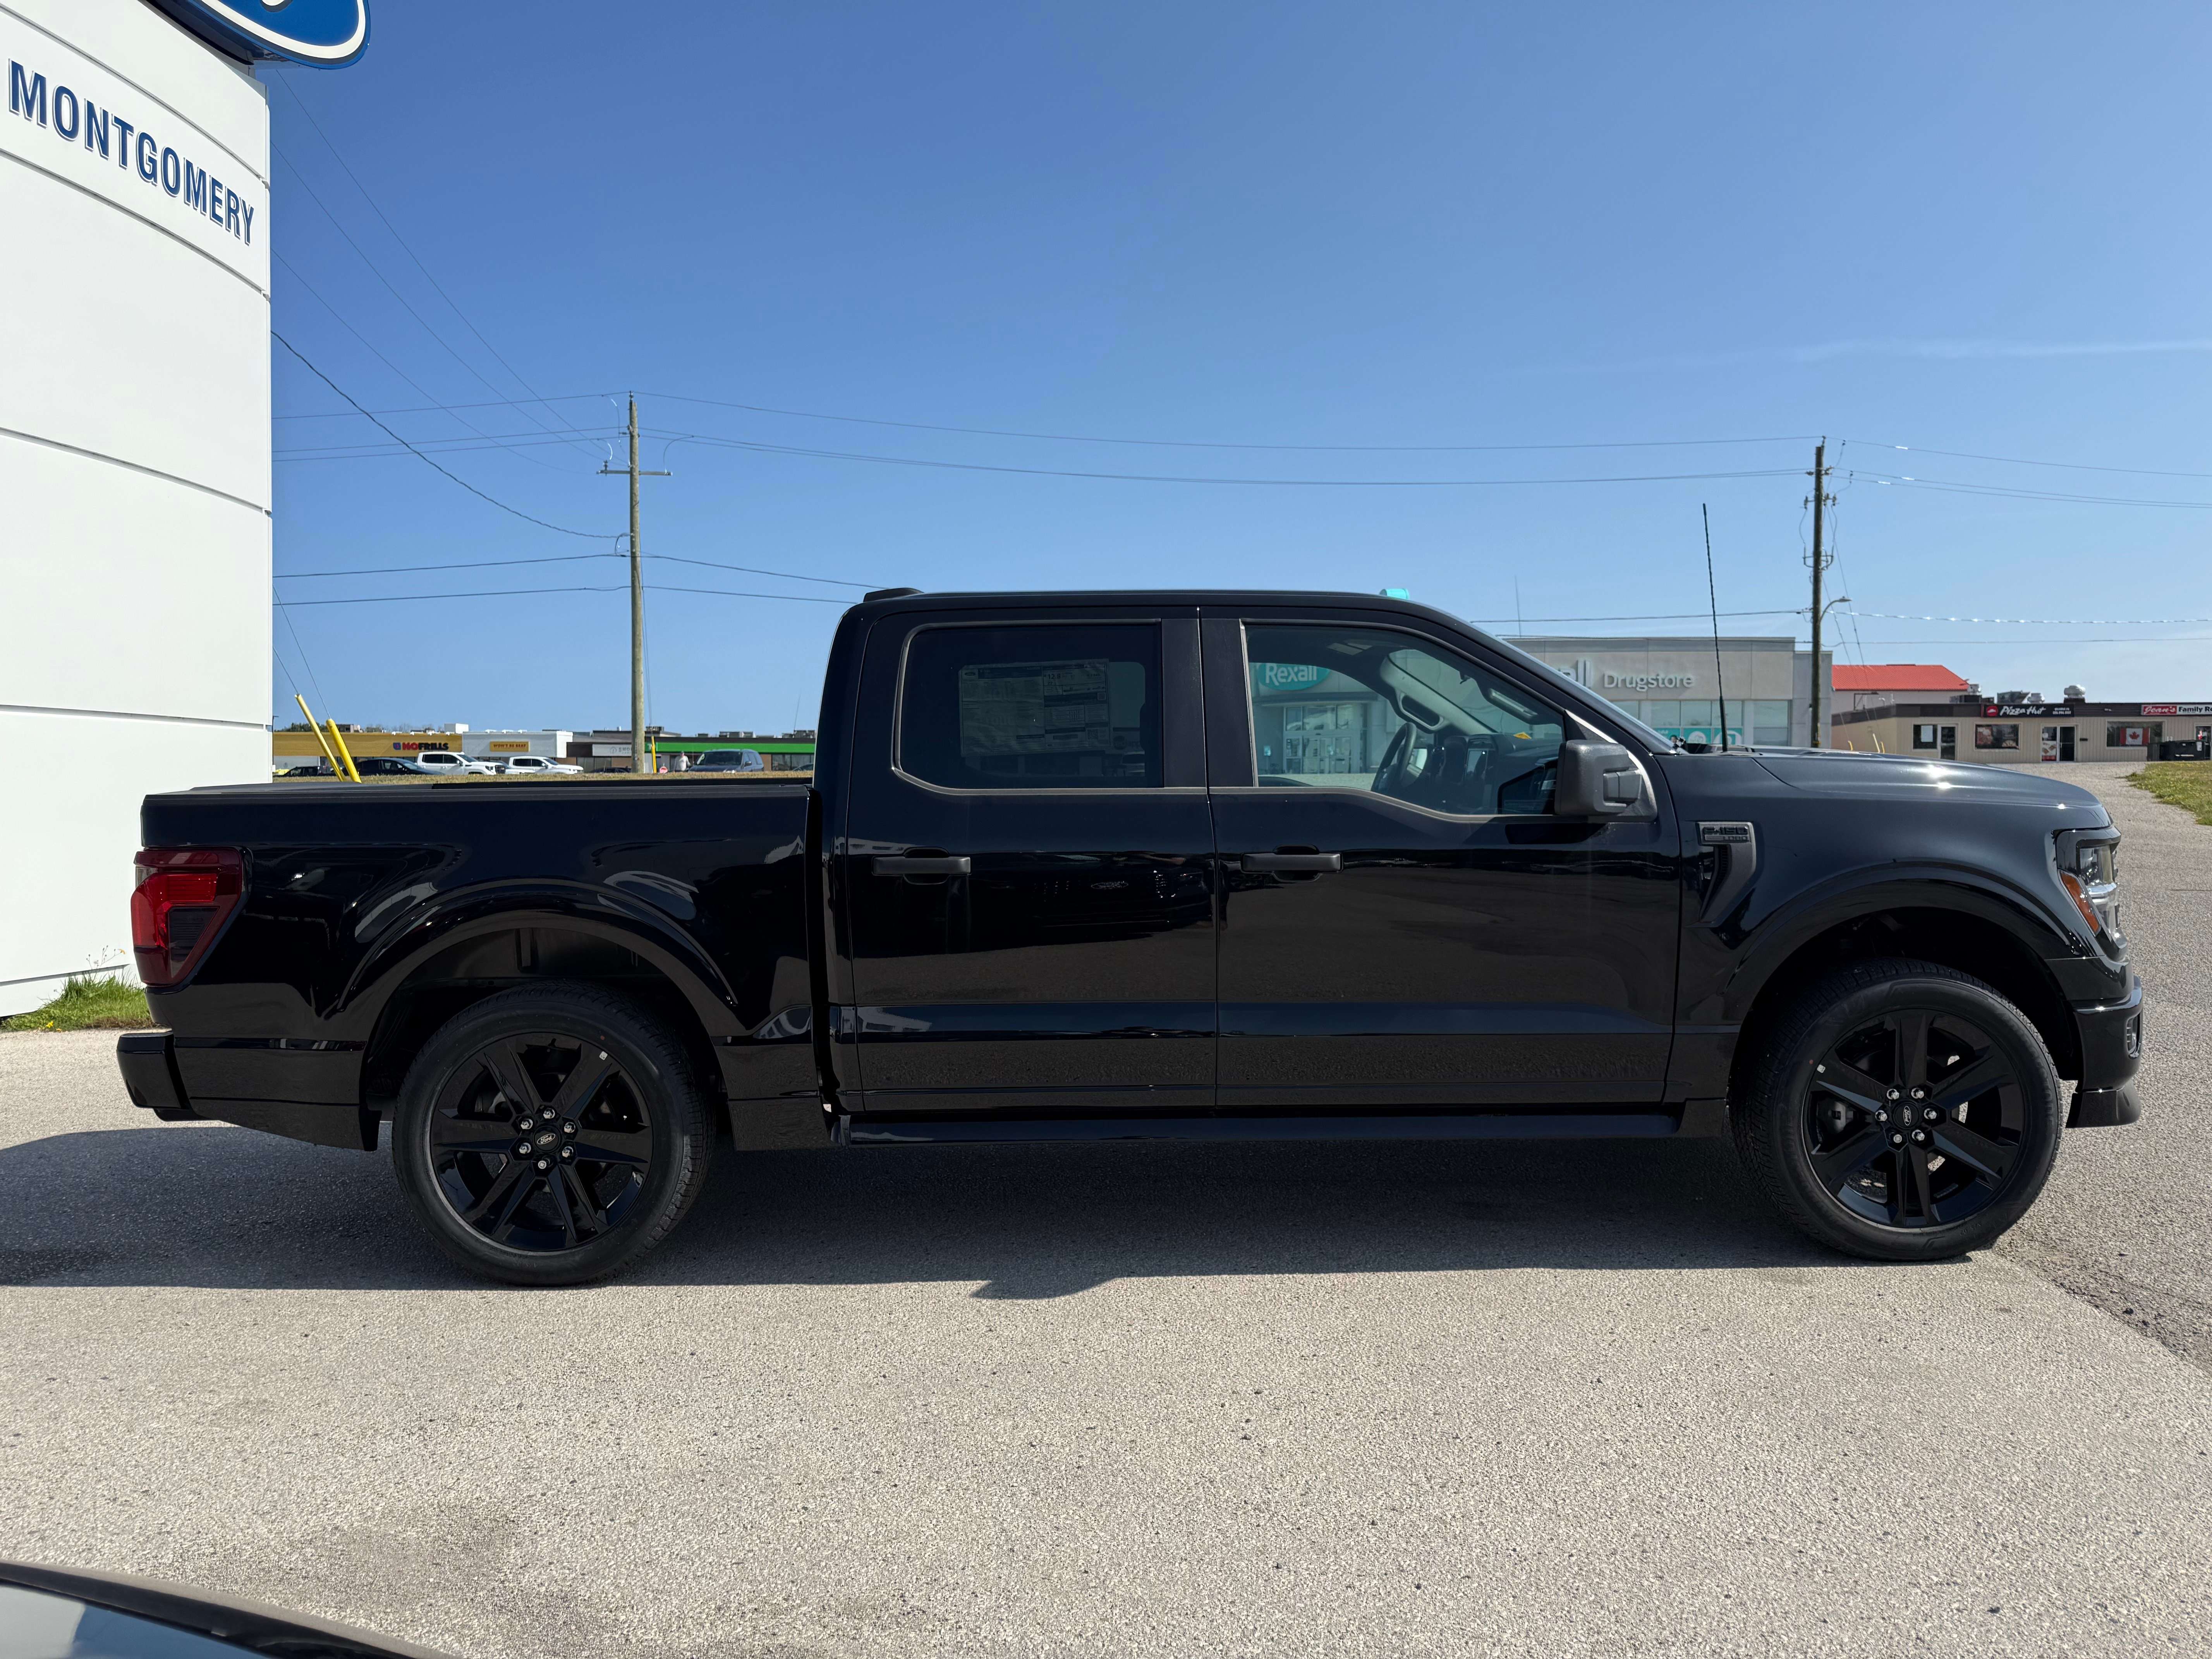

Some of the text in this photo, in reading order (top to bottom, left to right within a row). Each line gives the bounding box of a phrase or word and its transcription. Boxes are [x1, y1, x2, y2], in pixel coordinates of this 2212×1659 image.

[8, 58, 255, 247] MONTGOMERY
[1266, 663, 1317, 685] Rexall
[1604, 672, 1695, 691] Drugstore
[2000, 706, 2044, 716] Pizza Hut
[540, 1135, 553, 1144] Ford
